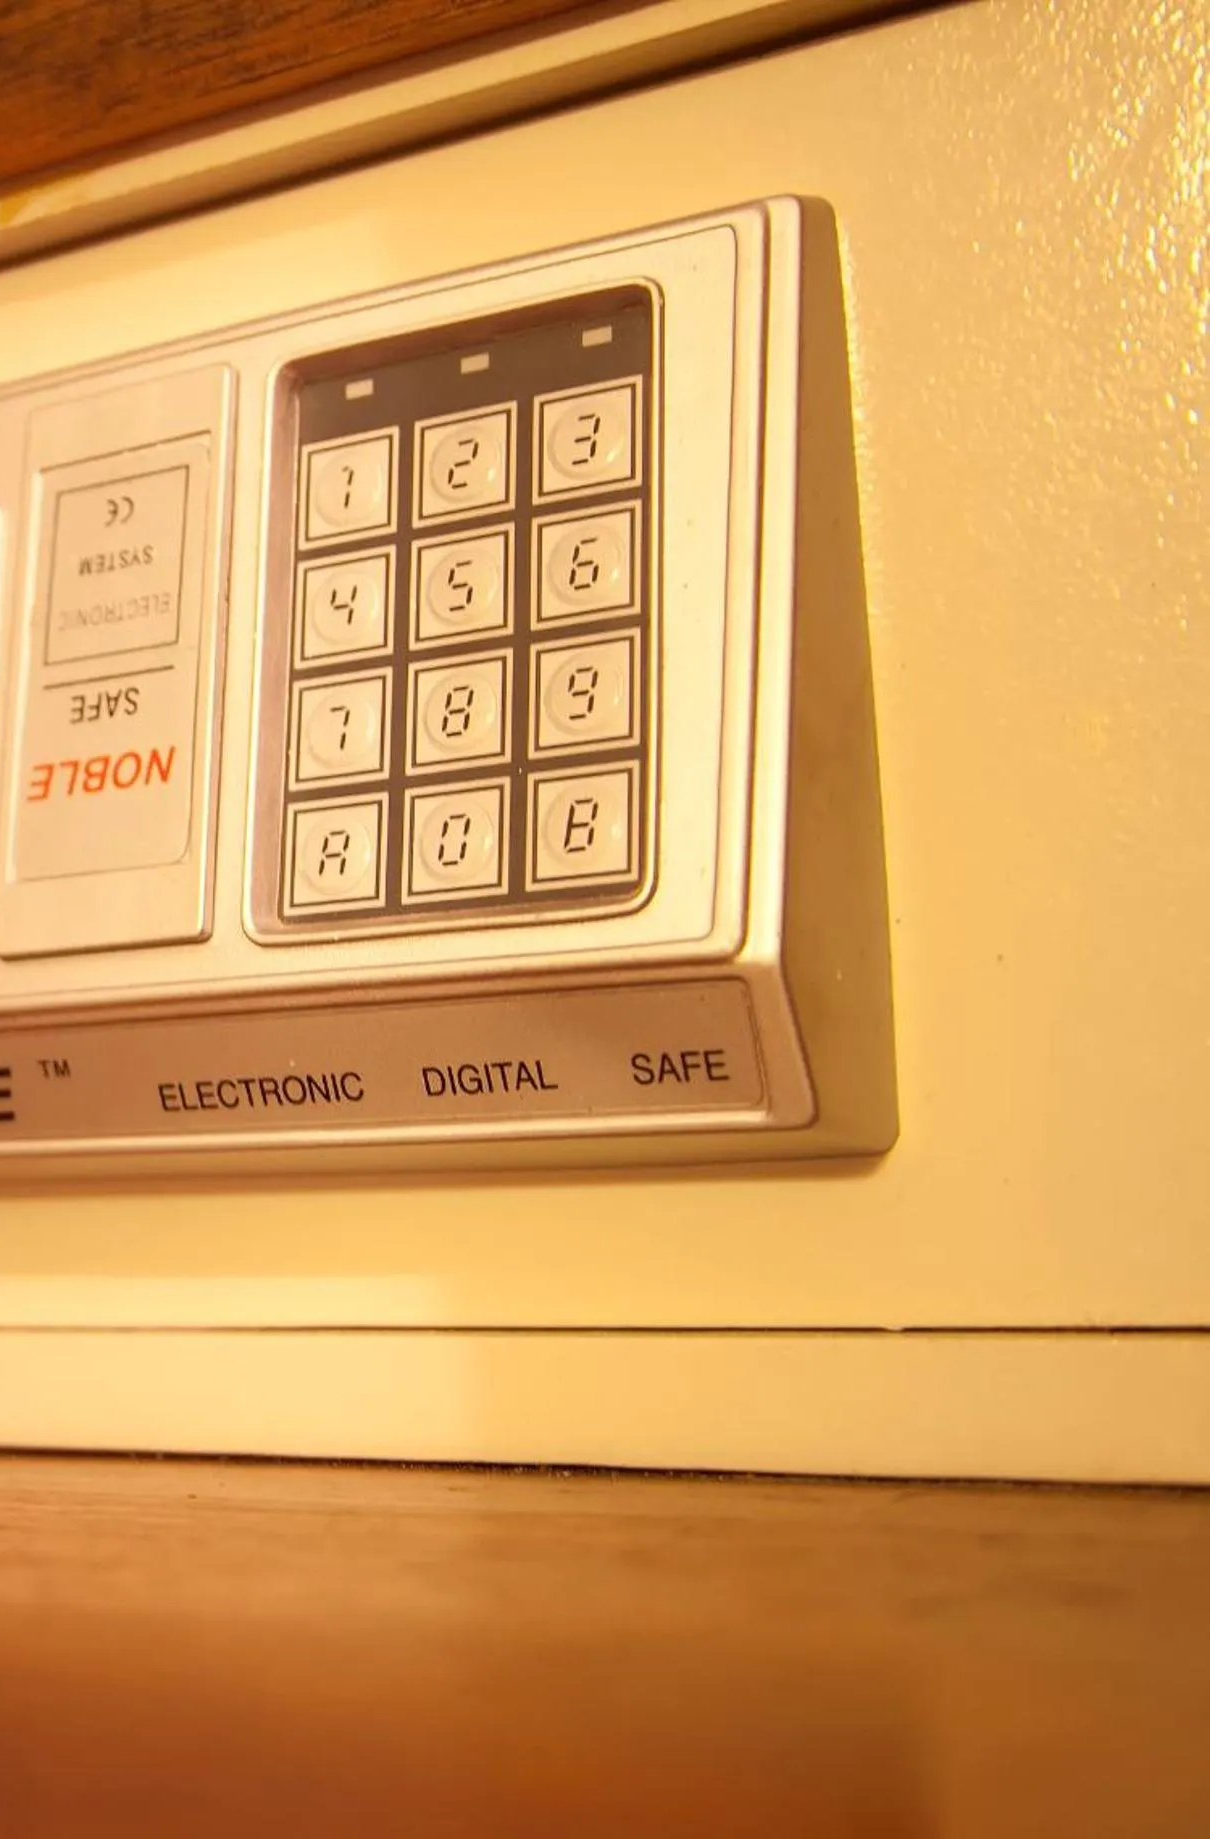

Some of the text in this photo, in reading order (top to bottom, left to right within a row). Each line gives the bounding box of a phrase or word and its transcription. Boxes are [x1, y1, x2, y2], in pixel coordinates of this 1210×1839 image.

[447, 438, 479, 489] 2
[571, 413, 600, 466] 3
[342, 465, 354, 509] 1
[78, 545, 154, 578] SYSTEM
[448, 560, 473, 612] 5
[569, 537, 599, 590] 6
[58, 592, 171, 631] ELECTRONIC
[330, 585, 358, 625] 4
[69, 686, 140, 725] SAFE
[441, 685, 474, 737] 8
[568, 667, 598, 721] 9
[329, 705, 350, 751] 7
[26, 745, 176, 803] NOBLE
[318, 830, 350, 876] A
[157, 1049, 730, 1112] ELECTRONIC DIGITAL SAFE
